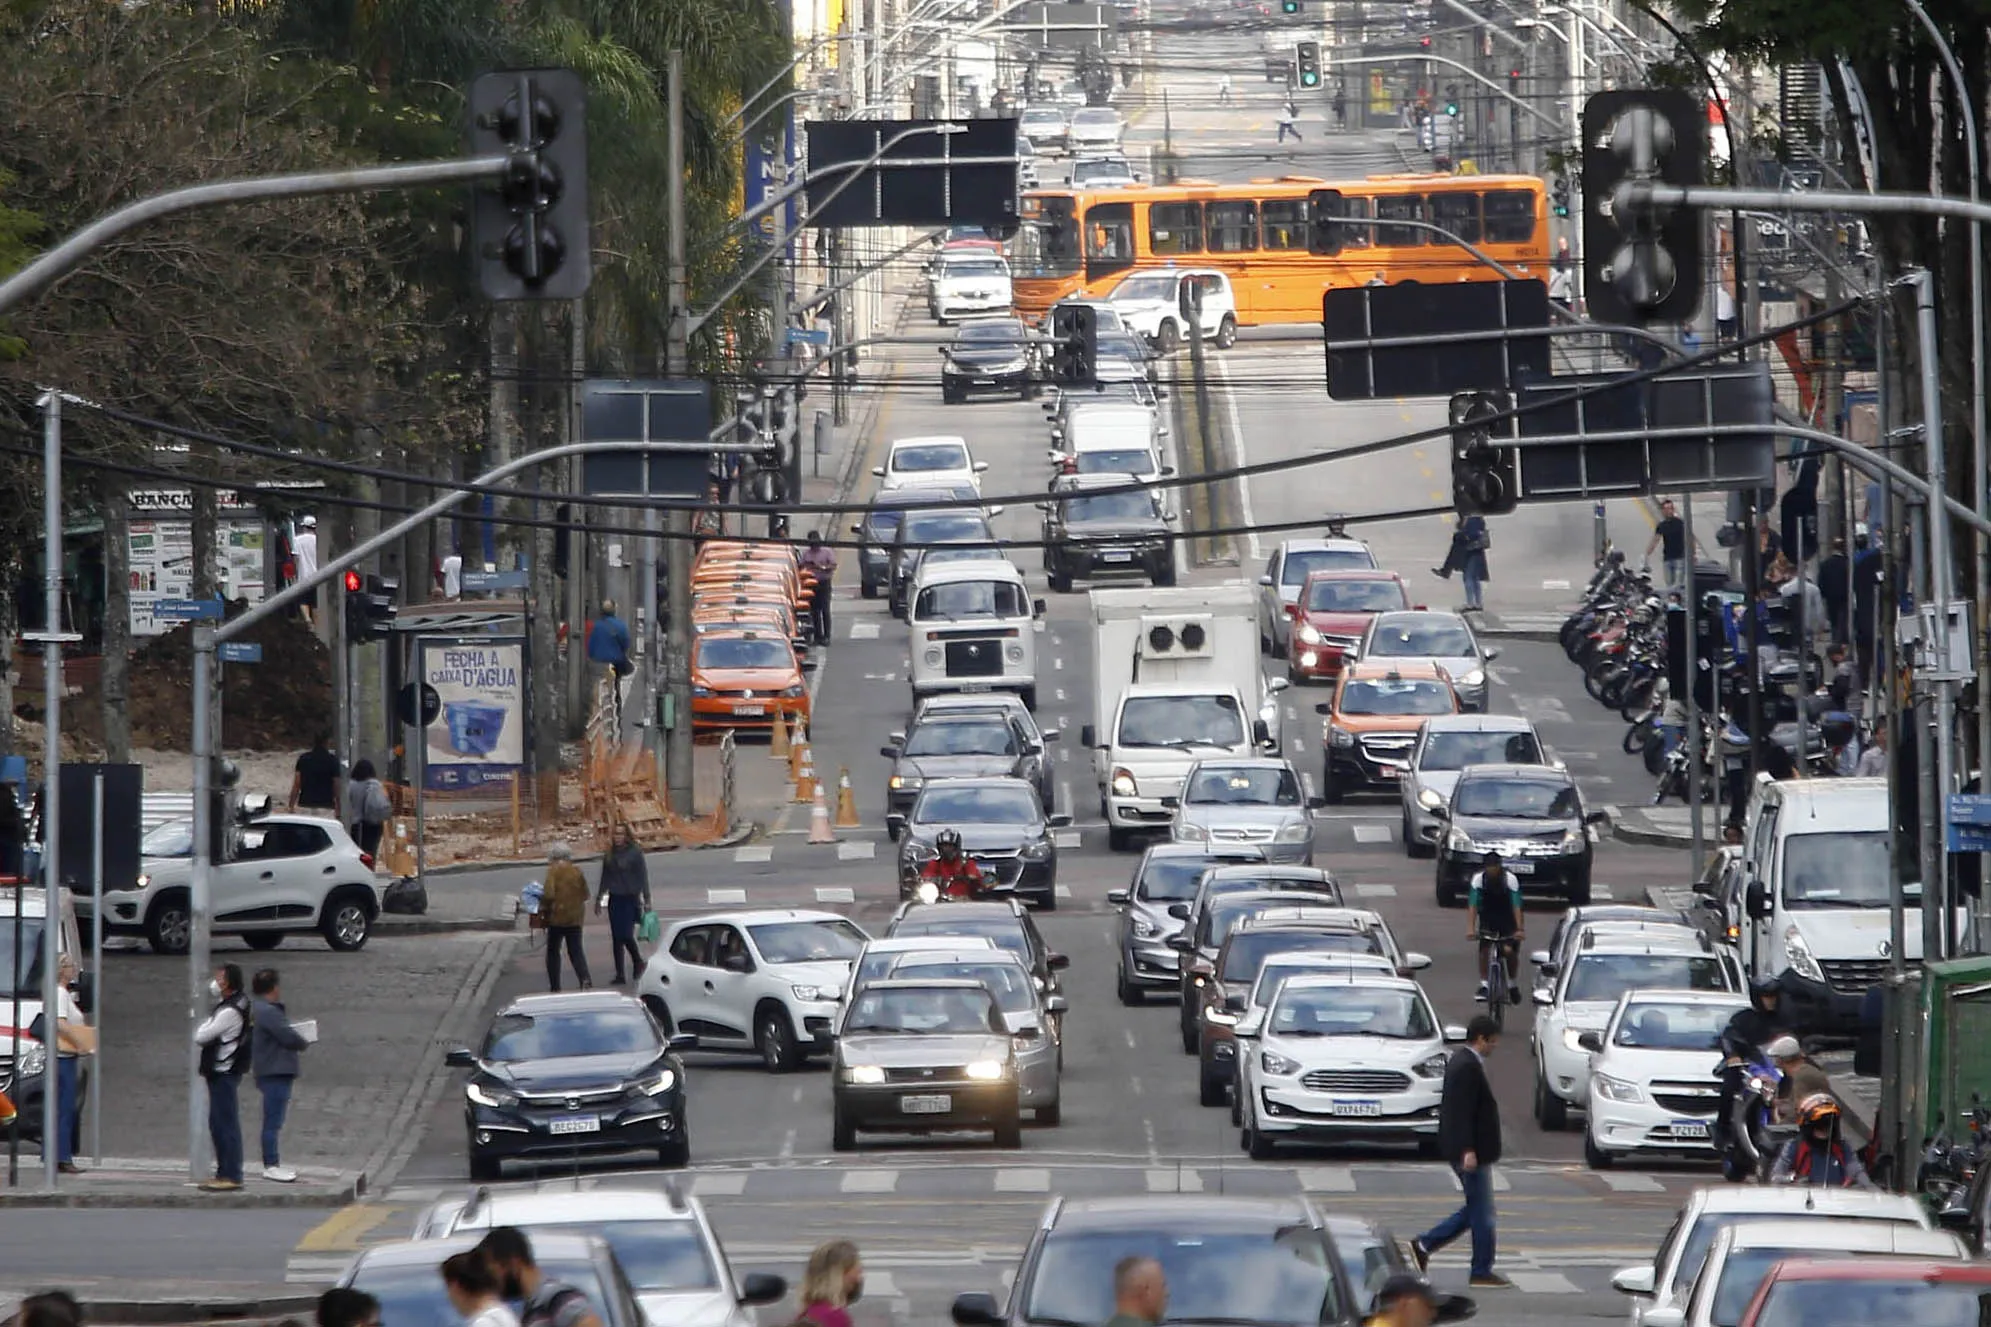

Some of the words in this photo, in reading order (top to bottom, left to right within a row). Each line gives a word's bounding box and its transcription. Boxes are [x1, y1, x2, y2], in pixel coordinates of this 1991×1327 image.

[134, 493, 193, 506] BANCA
[444, 651, 486, 668] FECHA
[490, 650, 499, 667] A
[431, 668, 462, 684] CAIXA
